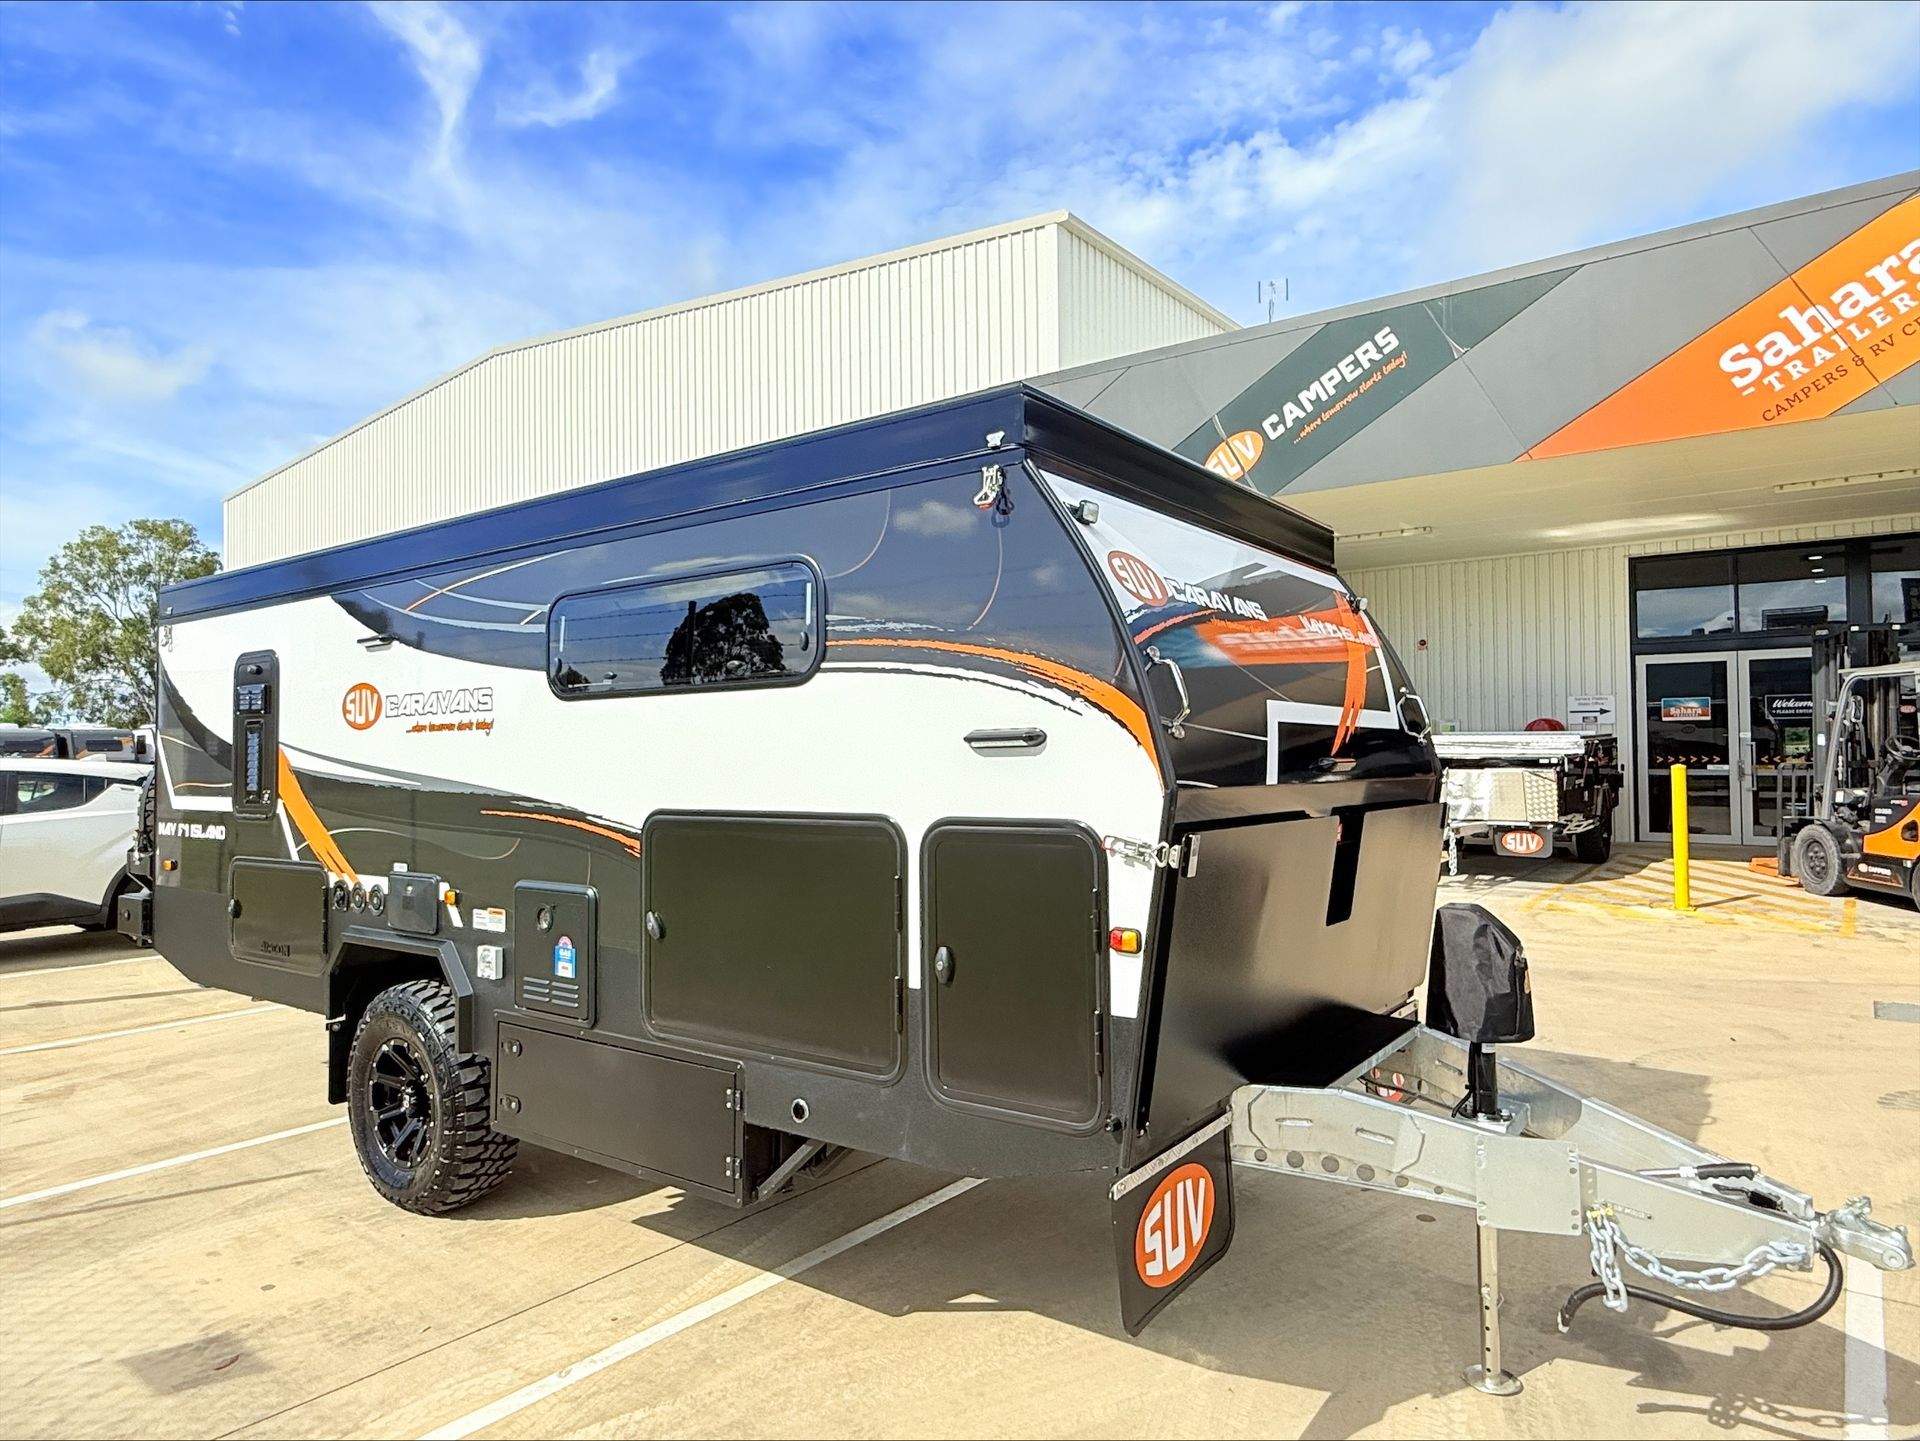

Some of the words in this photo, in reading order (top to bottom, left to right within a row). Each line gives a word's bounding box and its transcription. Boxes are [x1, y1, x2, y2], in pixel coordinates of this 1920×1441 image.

[1762, 279, 1920, 392] TRAILER
[1262, 326, 1400, 440] CAMPERS
[1321, 389, 1359, 422] tomorrow
[1359, 370, 1382, 394] starts
[1762, 364, 1848, 422] CAMPERS
[1852, 355, 1864, 367] &
[1869, 334, 1896, 356] RV
[1112, 557, 1163, 601] SUV
[1164, 577, 1269, 622] CARAVANS
[345, 689, 378, 725] SUV
[385, 687, 494, 718] CARAVANS
[1670, 706, 1702, 716] Sahara
[1506, 832, 1540, 851] SUV
[1144, 1177, 1206, 1276] SUV
